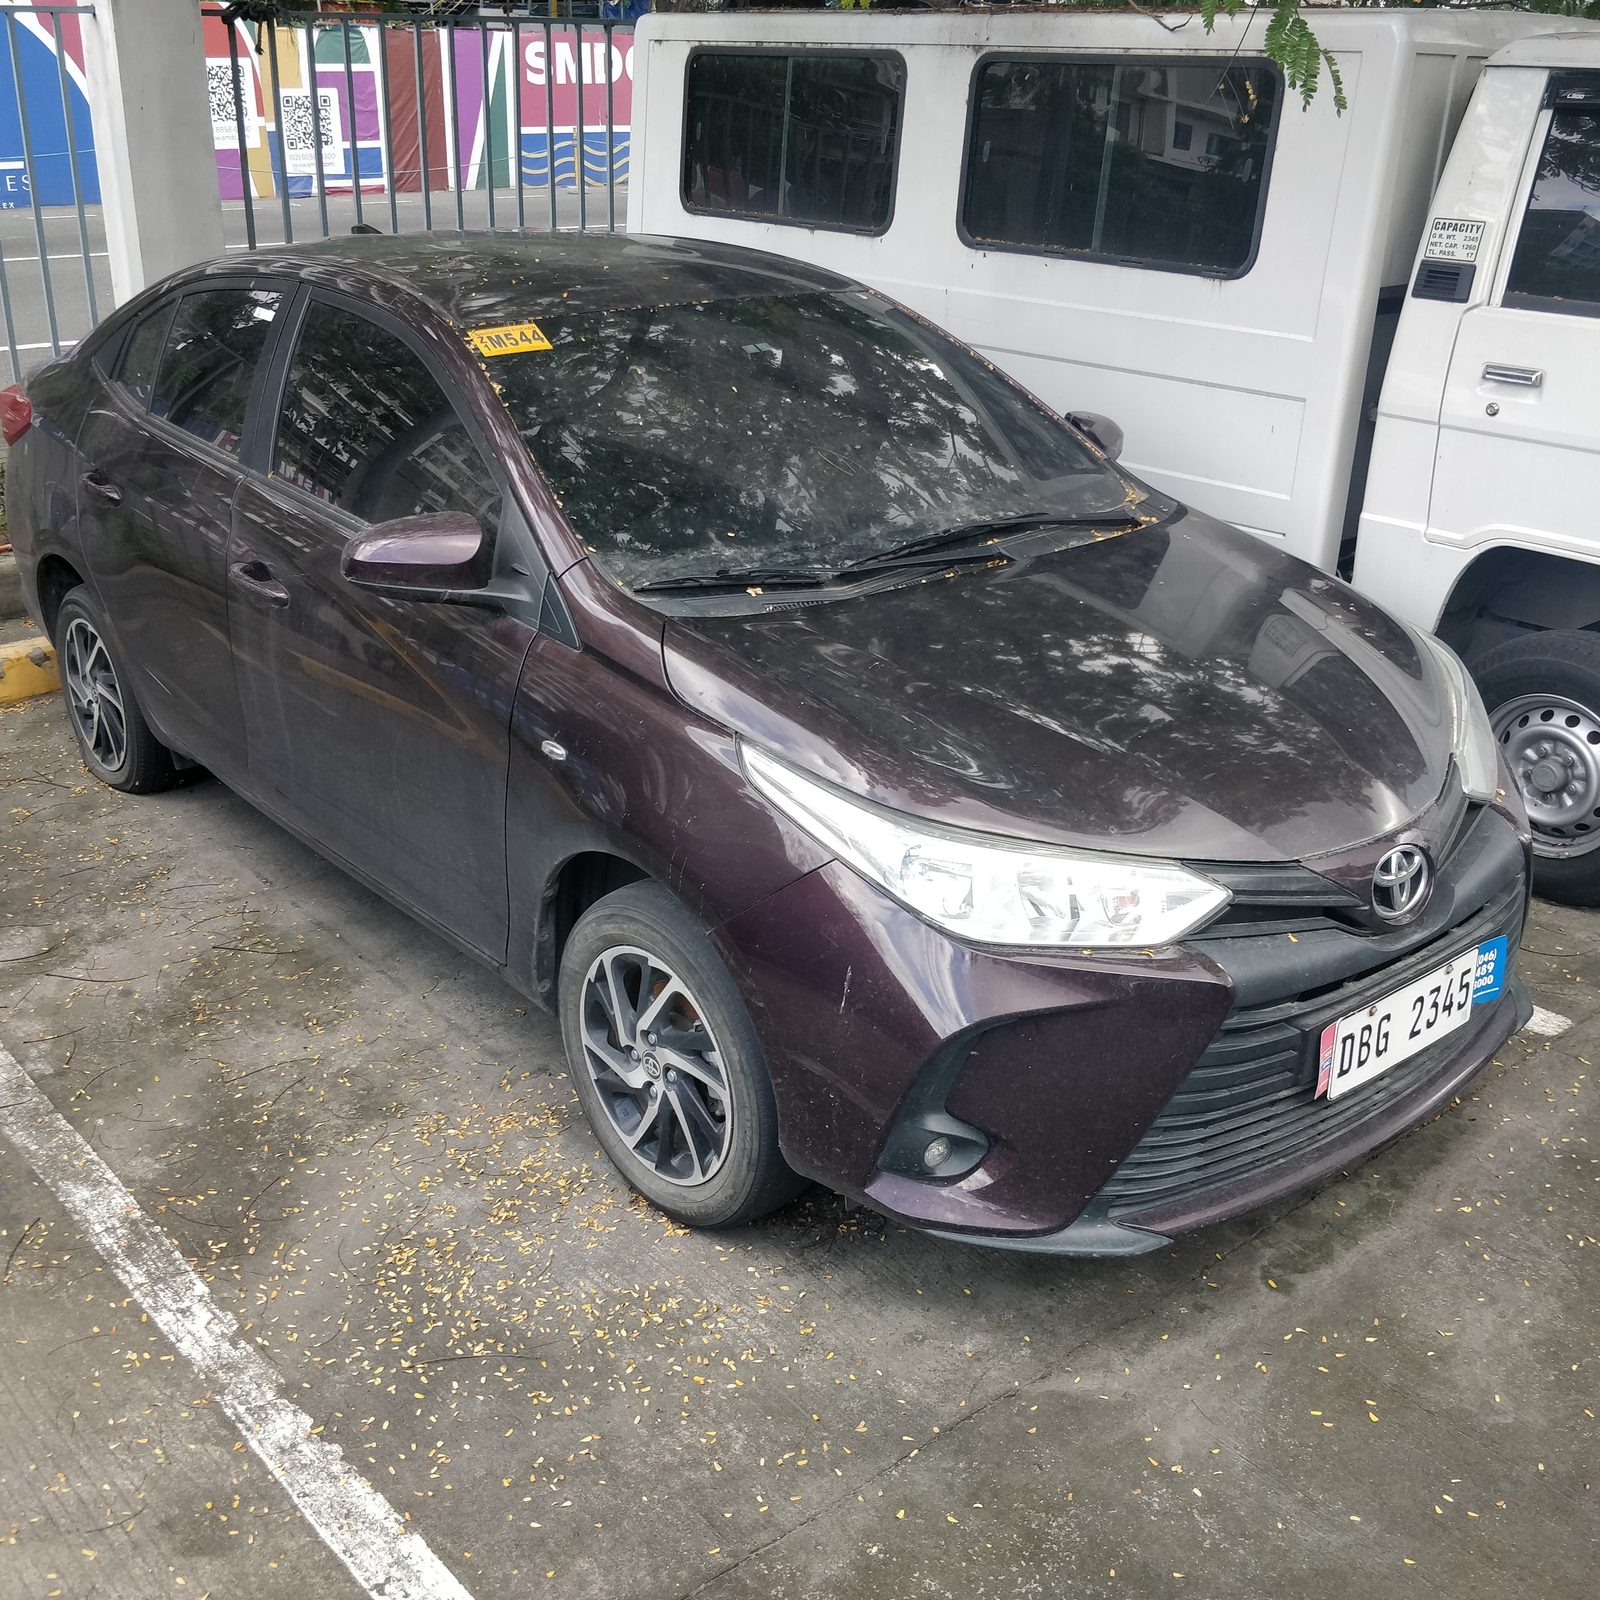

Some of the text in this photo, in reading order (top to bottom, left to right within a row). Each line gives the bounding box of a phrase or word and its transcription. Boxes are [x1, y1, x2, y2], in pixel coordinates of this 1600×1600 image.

[1434, 221, 1481, 234] CAPACITY
[1475, 962, 1494, 977] 489
[1337, 967, 1472, 1079] DBG 2345
